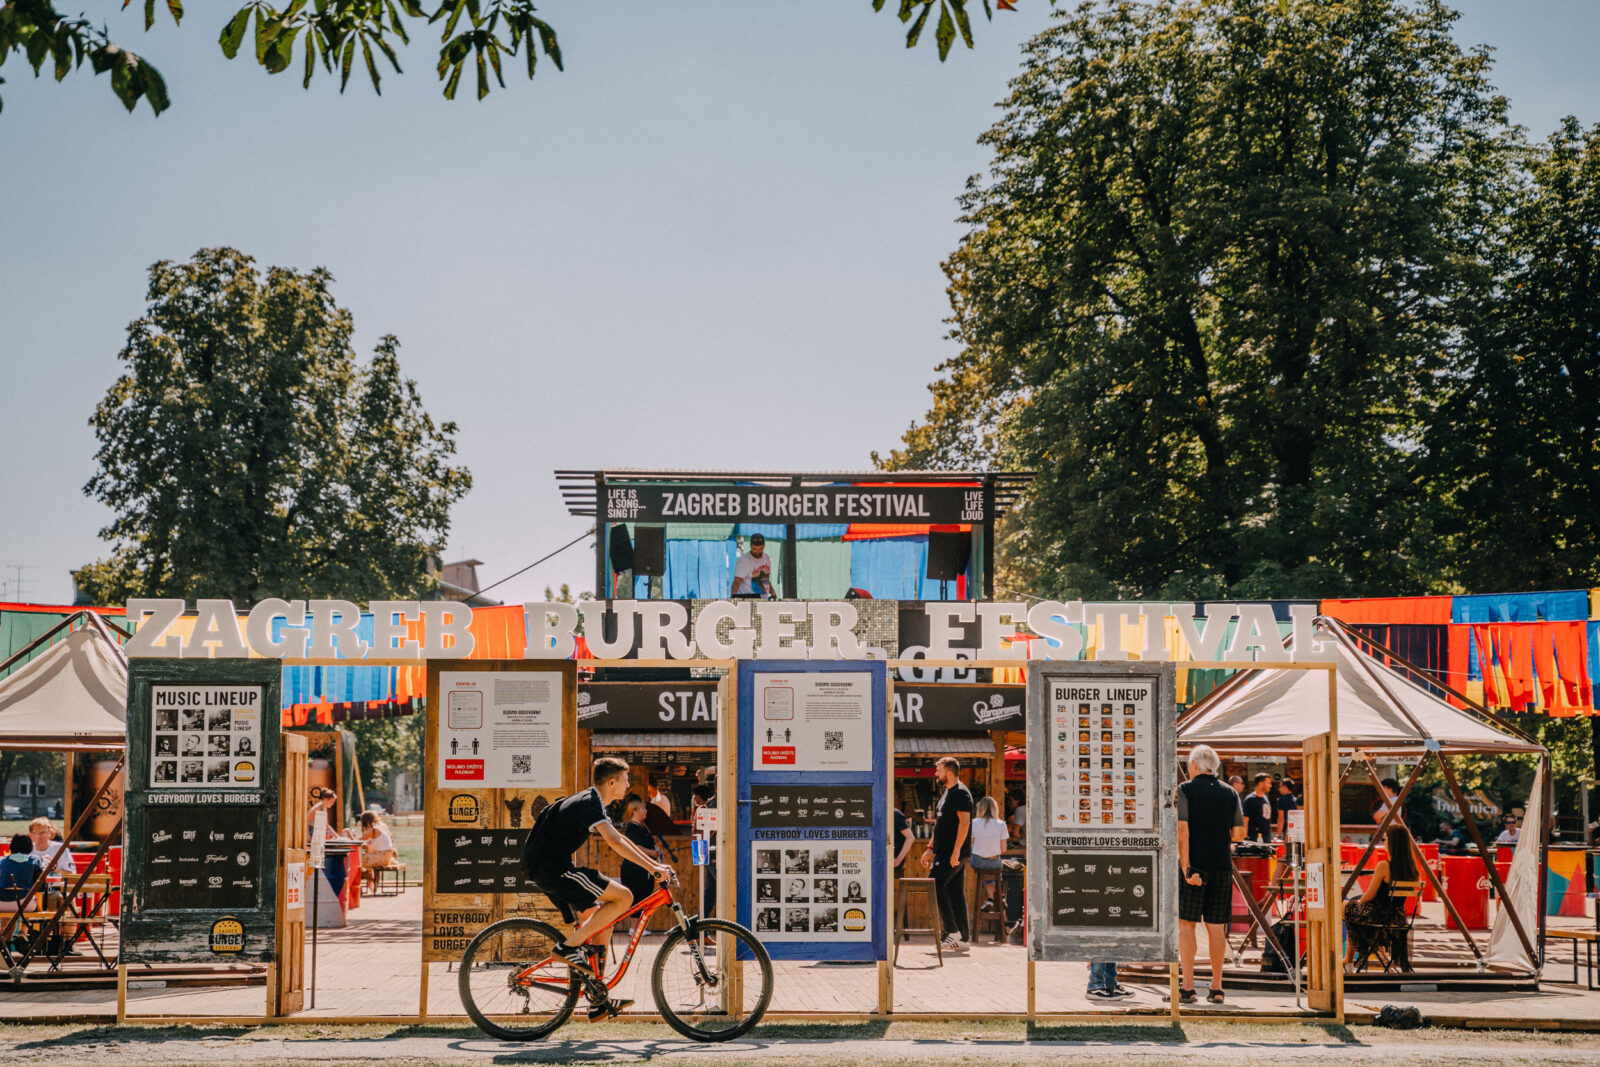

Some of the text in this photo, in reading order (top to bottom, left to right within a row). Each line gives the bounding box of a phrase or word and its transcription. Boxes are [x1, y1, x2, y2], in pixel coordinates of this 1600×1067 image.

[608, 489, 637, 499] LIFE IS
[964, 491, 984, 501] LIVE
[607, 499, 646, 509] A SONG...
[661, 492, 931, 517] ZAGREB BURGER FESTIVAL
[965, 500, 984, 511] LIFE
[607, 508, 638, 518] SING IT
[961, 510, 984, 521] LOUD
[124, 597, 1338, 662] ZAGREB BURGER FESTIVAL
[156, 691, 257, 706] MUSIC LINEUP
[1055, 688, 1148, 701] BURGER LINEUP
[973, 701, 1022, 725] Staropramen
[148, 793, 261, 804] EVERYBODY LOVES BURGERS
[1436, 800, 1498, 814] botnica
[755, 829, 869, 839] EVERYBODY LOVES BURGERS
[1045, 836, 1159, 847] EVERYBODY LOVES BURGERS
[433, 912, 490, 924] EVERYBODY
[433, 926, 465, 937] LOVES
